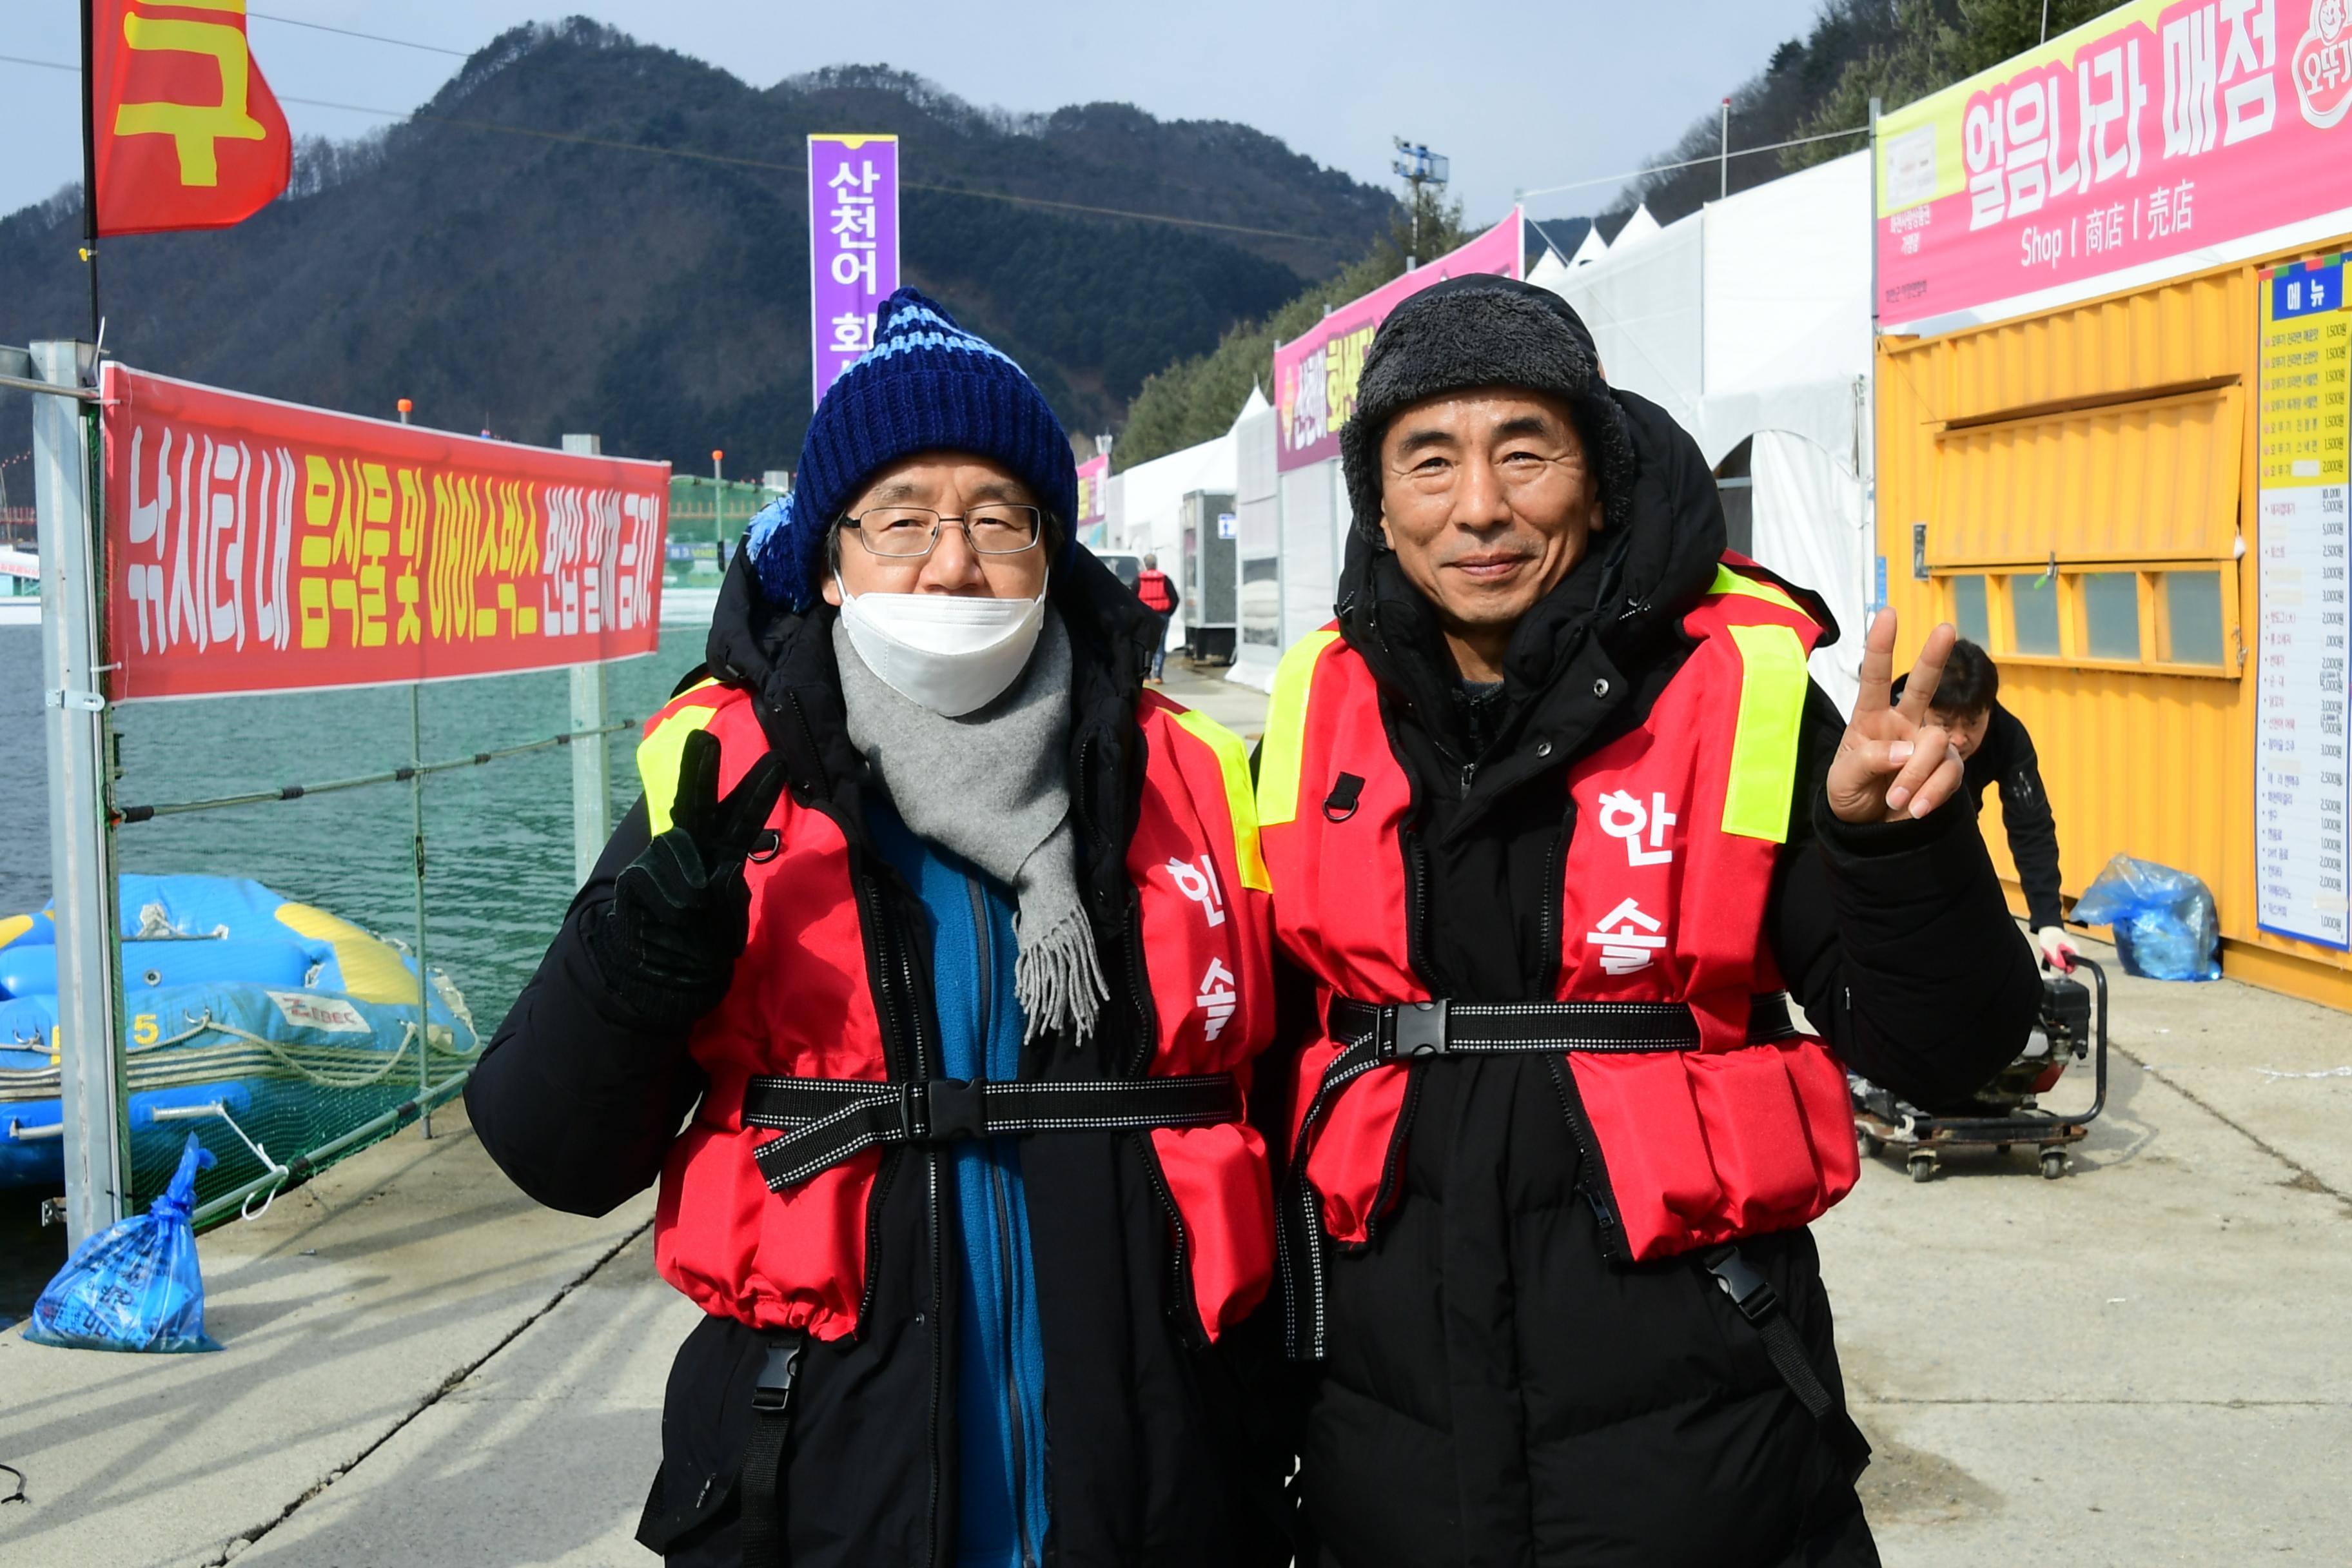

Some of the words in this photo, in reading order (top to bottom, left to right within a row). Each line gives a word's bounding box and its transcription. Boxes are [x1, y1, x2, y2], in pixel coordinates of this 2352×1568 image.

[1966, 38, 2146, 231] 얼음나라
[2163, 0, 2275, 159] 매점
[828, 160, 881, 295] 산천어
[2021, 226, 2061, 270] Shop
[2086, 202, 2124, 257] 商店
[2148, 178, 2195, 240] 売店
[128, 425, 251, 654] 낚시터
[255, 446, 295, 652] 내
[299, 455, 391, 649] 음식물
[396, 467, 426, 645] 및
[427, 470, 538, 644] 아이스박스
[543, 485, 583, 637] 반입
[583, 488, 622, 634] 일체
[620, 492, 660, 631] 금지!
[1164, 854, 1237, 1042] 한솔
[1586, 789, 1676, 975] 한솔
[134, 1014, 159, 1045] 5
